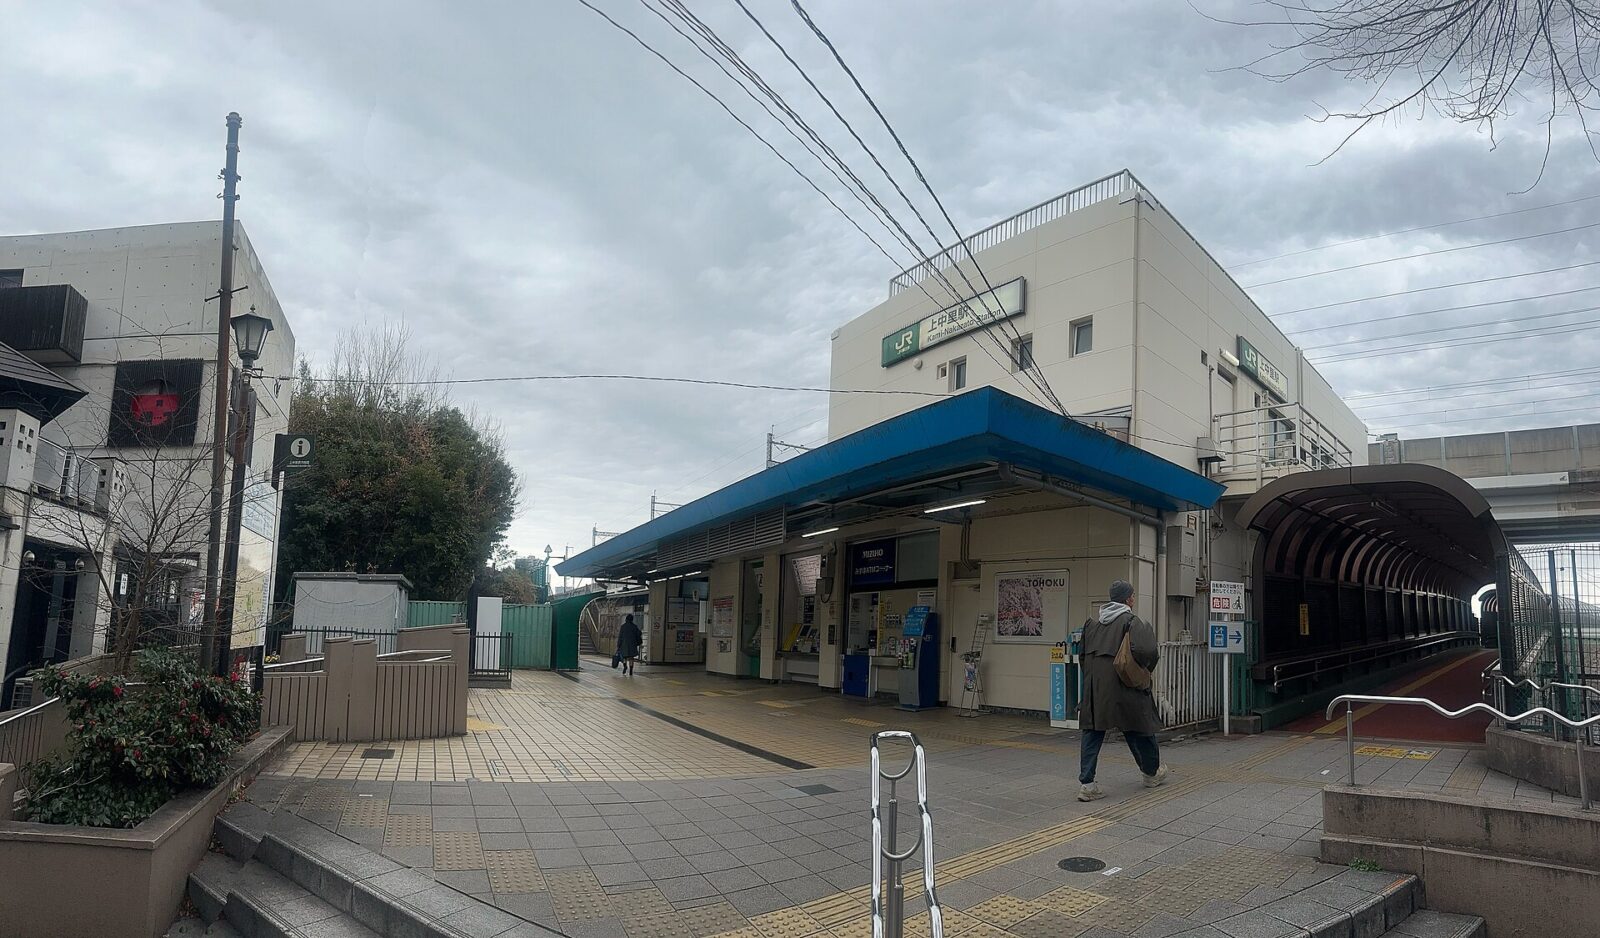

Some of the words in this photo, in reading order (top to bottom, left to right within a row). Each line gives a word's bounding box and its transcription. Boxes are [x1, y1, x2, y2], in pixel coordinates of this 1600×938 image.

[928, 306, 970, 333] 上中里駅
[895, 330, 913, 350] JR
[927, 319, 974, 342] Kami-Nakazato
[1245, 348, 1257, 367] JR
[1027, 578, 1065, 587] TOHOKU
[1213, 597, 1230, 609] 危険
